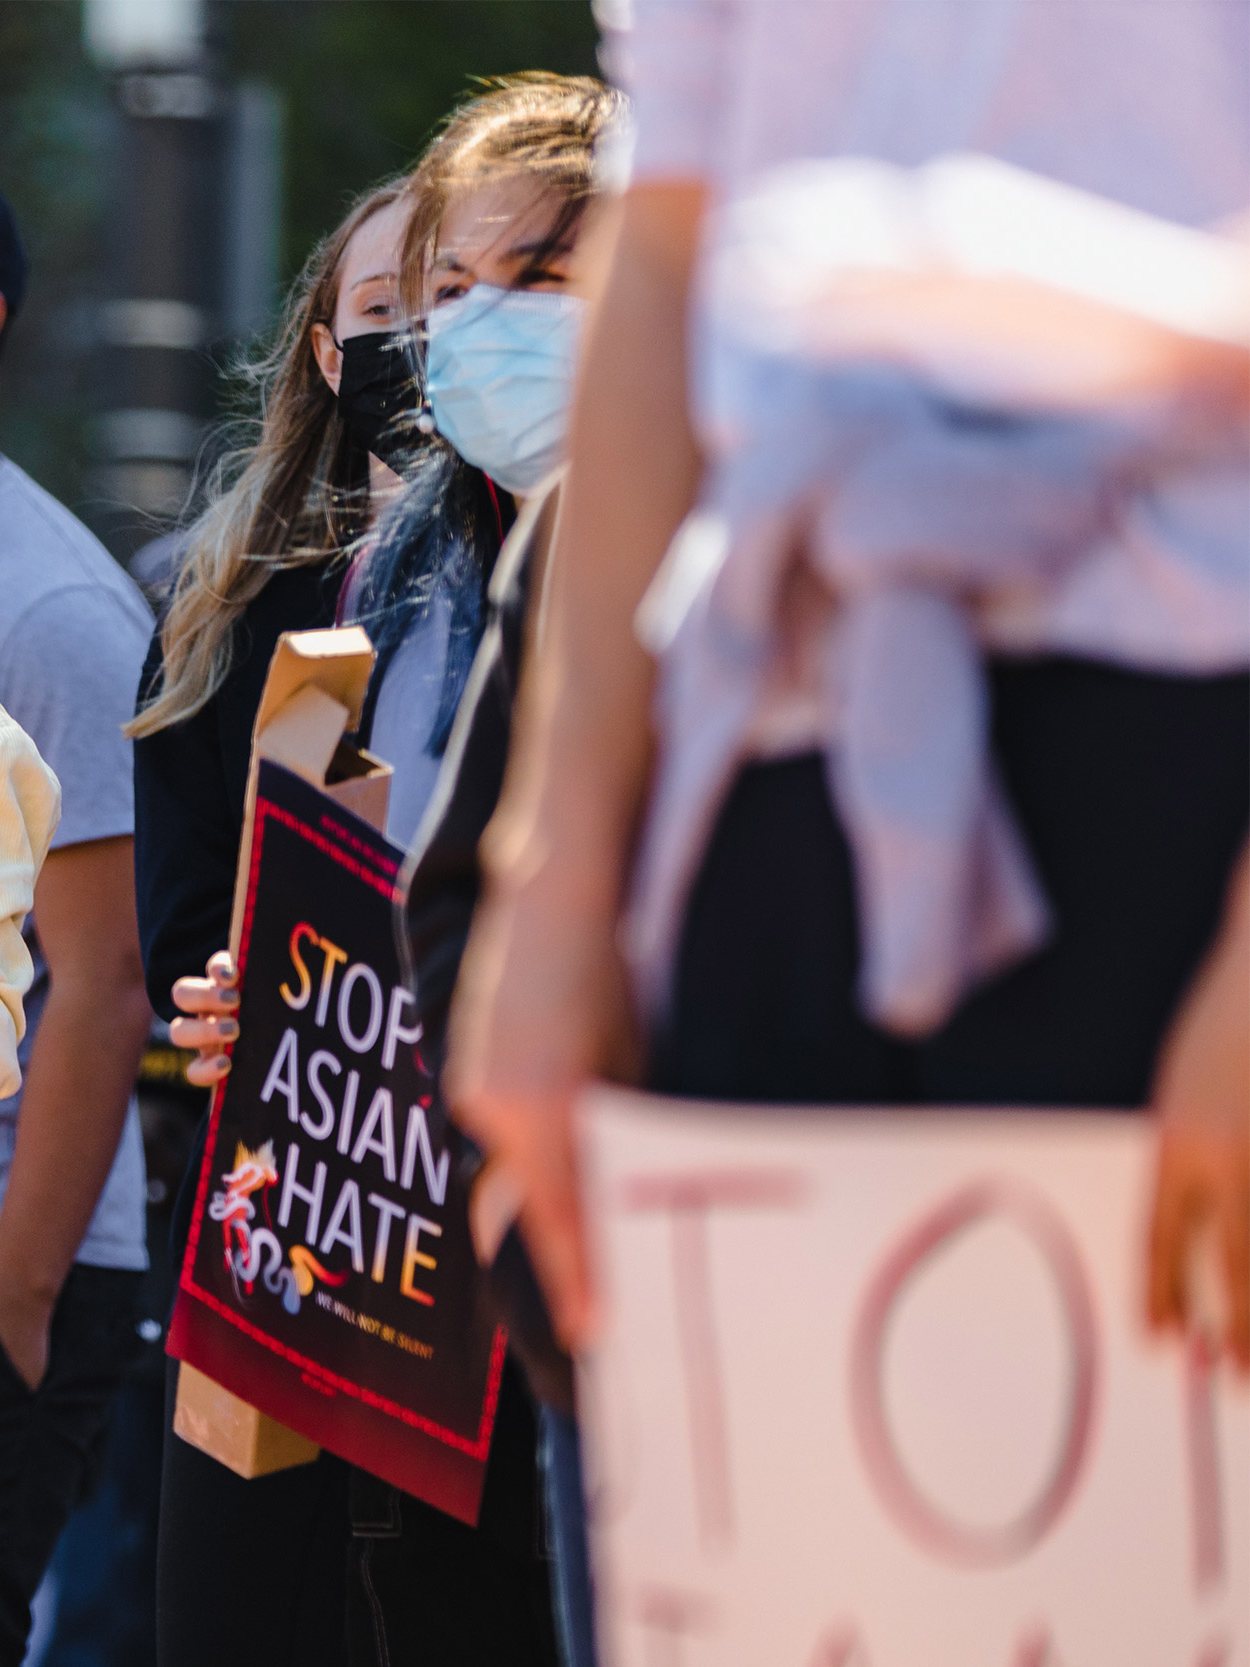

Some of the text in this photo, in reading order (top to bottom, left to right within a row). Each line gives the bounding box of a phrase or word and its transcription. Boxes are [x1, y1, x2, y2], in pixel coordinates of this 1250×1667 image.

[279, 921, 423, 1070] STOP
[260, 1027, 450, 1206] ASIAN
[277, 1142, 443, 1307] HATE
